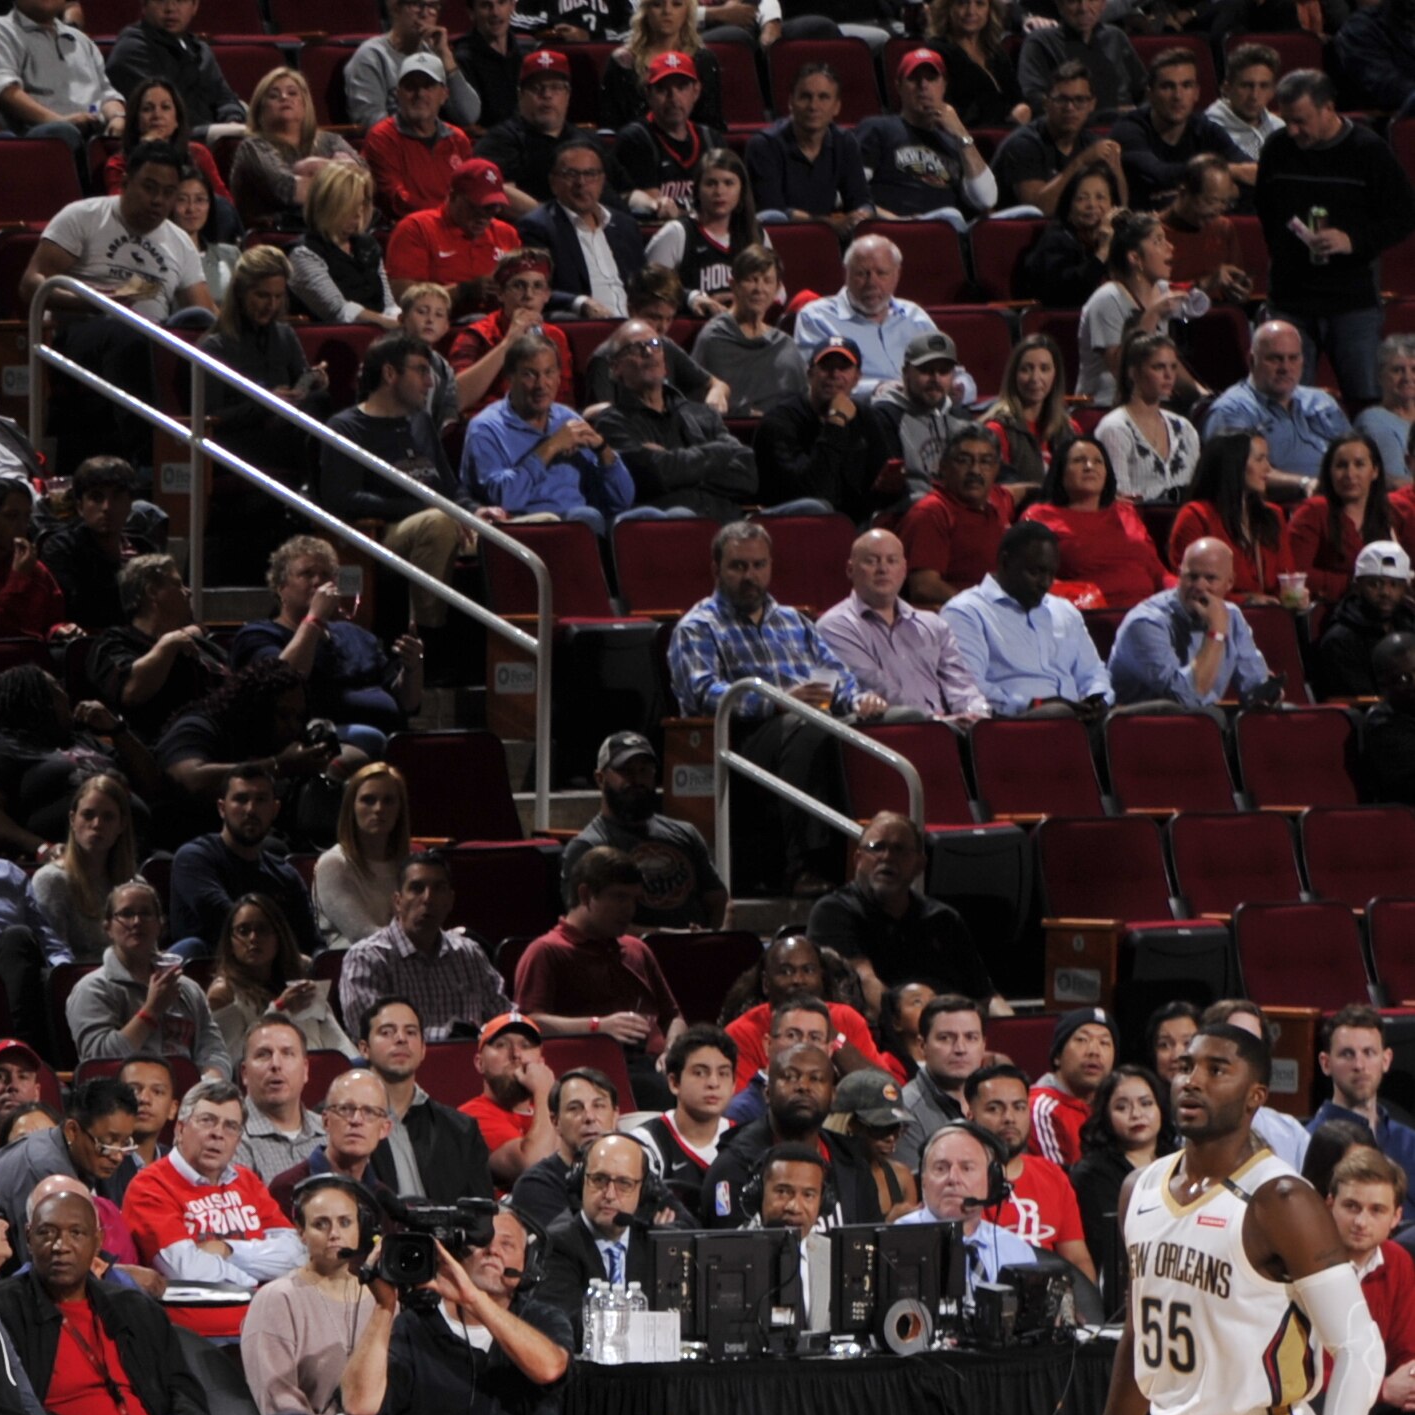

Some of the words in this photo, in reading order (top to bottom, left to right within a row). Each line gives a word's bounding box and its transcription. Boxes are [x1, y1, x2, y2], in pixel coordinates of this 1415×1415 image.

[1128, 1242, 1152, 1280] EW
[1155, 1242, 1233, 1299] ORLEANS
[1141, 1297, 1196, 1374] 55
